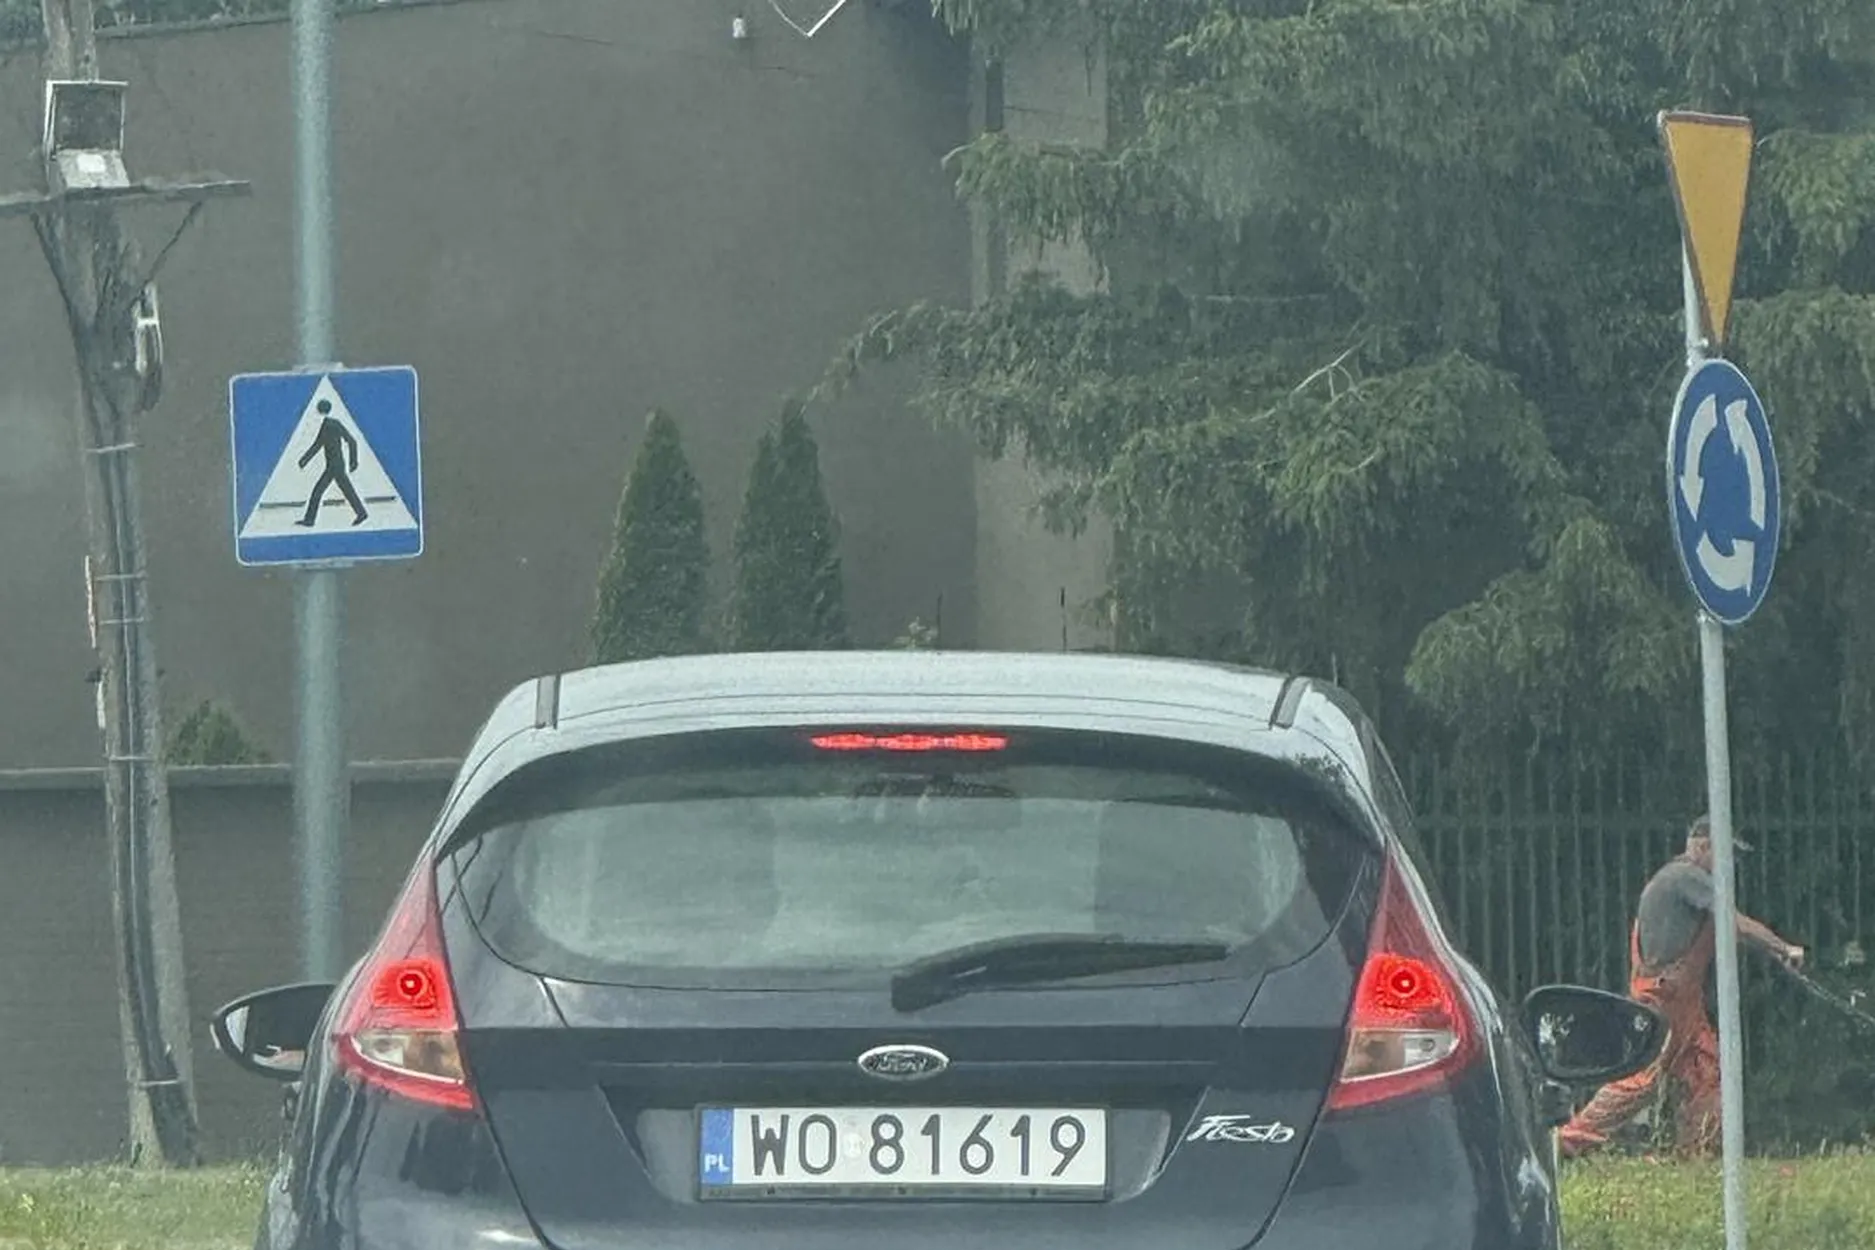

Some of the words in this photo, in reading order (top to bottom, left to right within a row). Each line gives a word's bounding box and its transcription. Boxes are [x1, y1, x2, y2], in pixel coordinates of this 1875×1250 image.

[1187, 1114, 1295, 1143] Fiesta
[751, 1114, 837, 1176] WO
[869, 1114, 1086, 1177] 81619
[704, 1153, 730, 1173] PL
